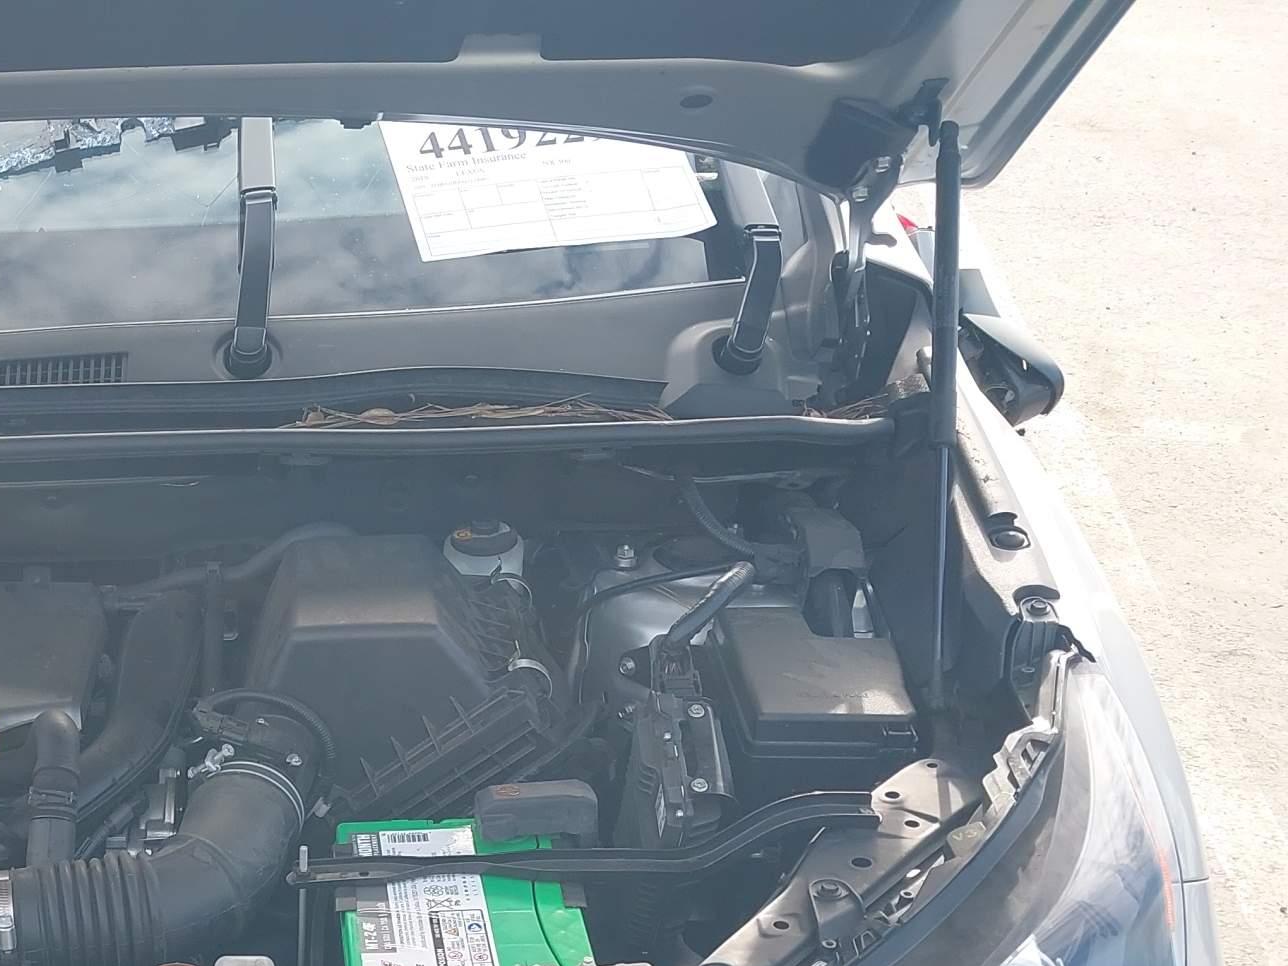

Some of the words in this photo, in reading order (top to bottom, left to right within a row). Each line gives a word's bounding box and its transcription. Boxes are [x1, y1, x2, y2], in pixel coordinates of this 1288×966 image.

[405, 162, 436, 174] State
[438, 158, 469, 169] Farm
[472, 152, 527, 167] Insurance
